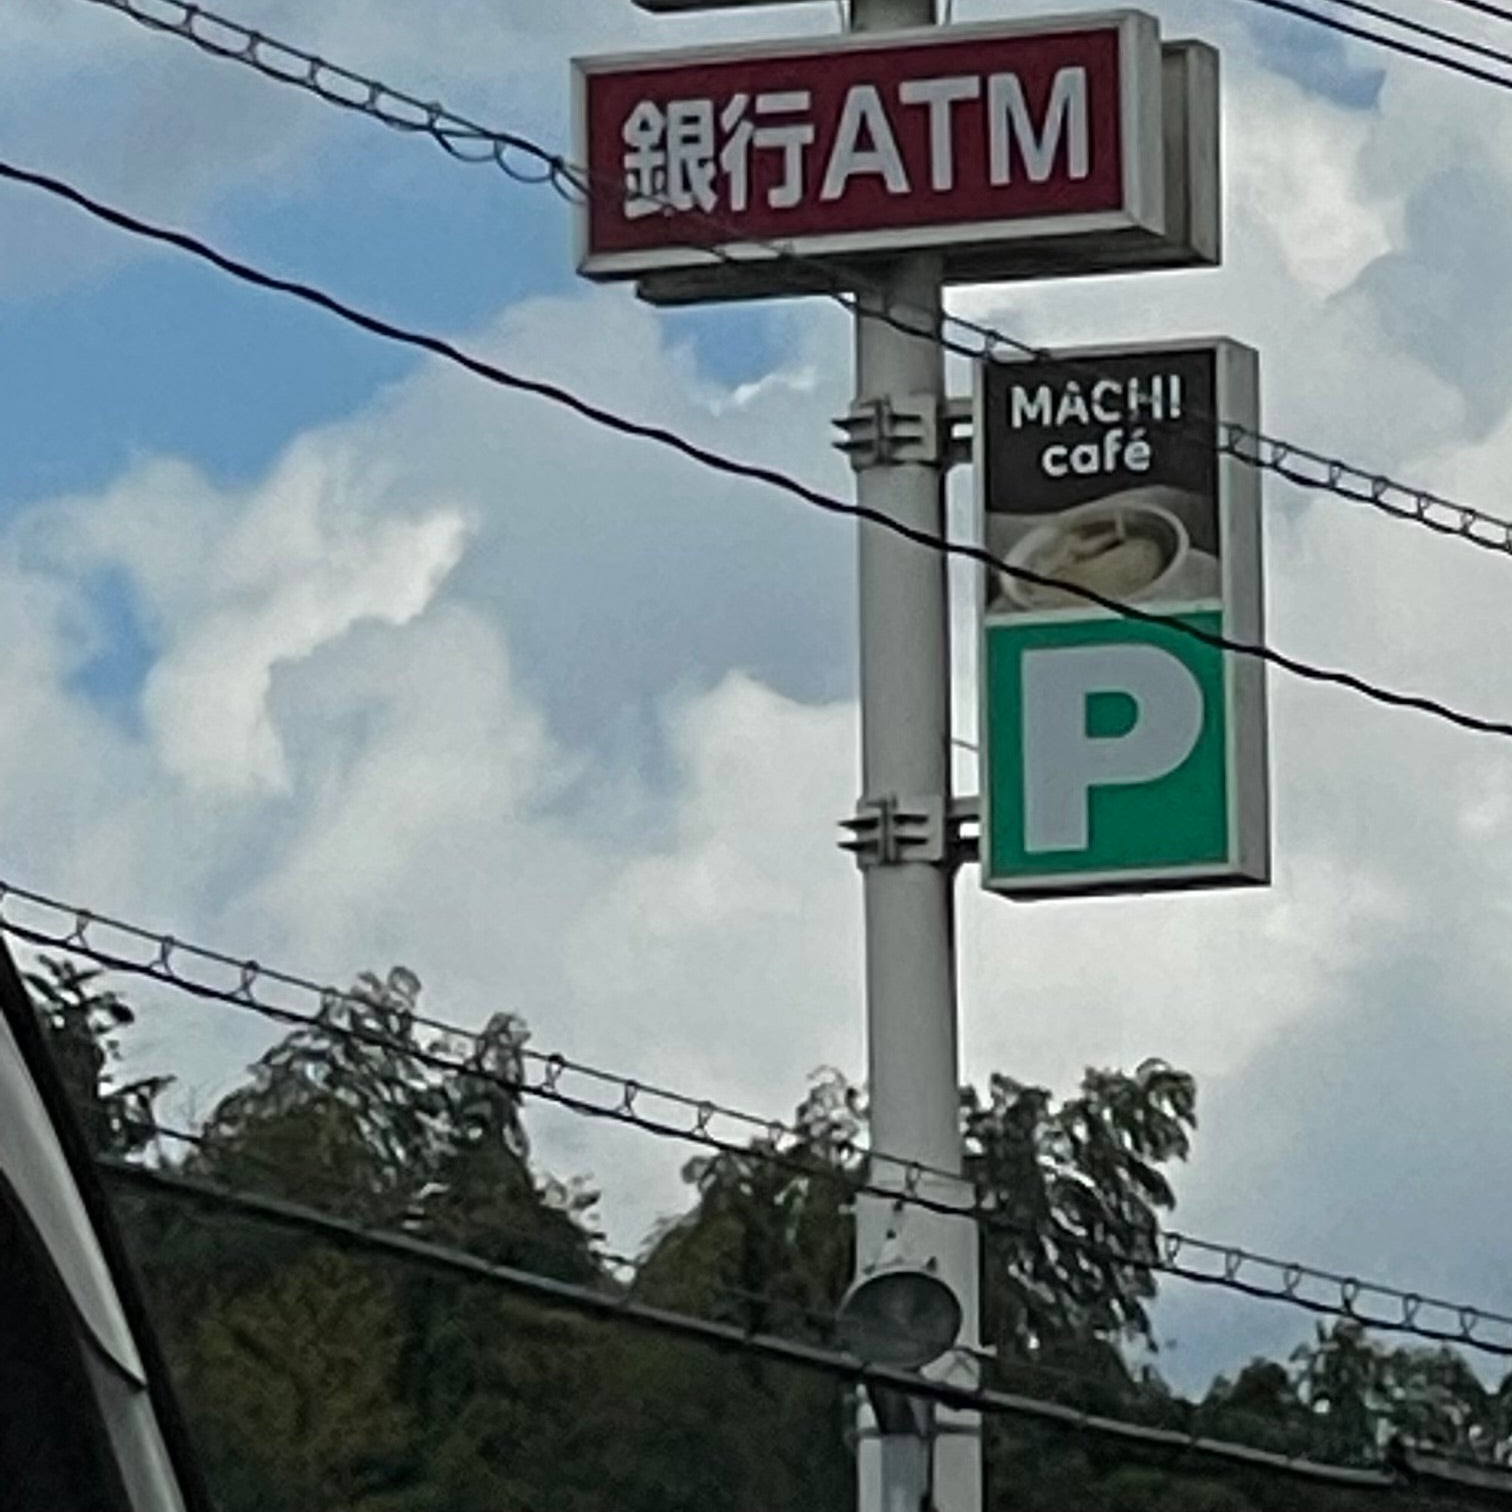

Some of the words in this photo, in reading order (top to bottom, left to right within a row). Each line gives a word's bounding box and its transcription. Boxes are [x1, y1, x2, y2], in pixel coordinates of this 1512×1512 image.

[623, 66, 1090, 219] 銀行ATM
[1010, 374, 1182, 429] MACHI
[1042, 428, 1151, 477] café
[1021, 643, 1205, 853] P
